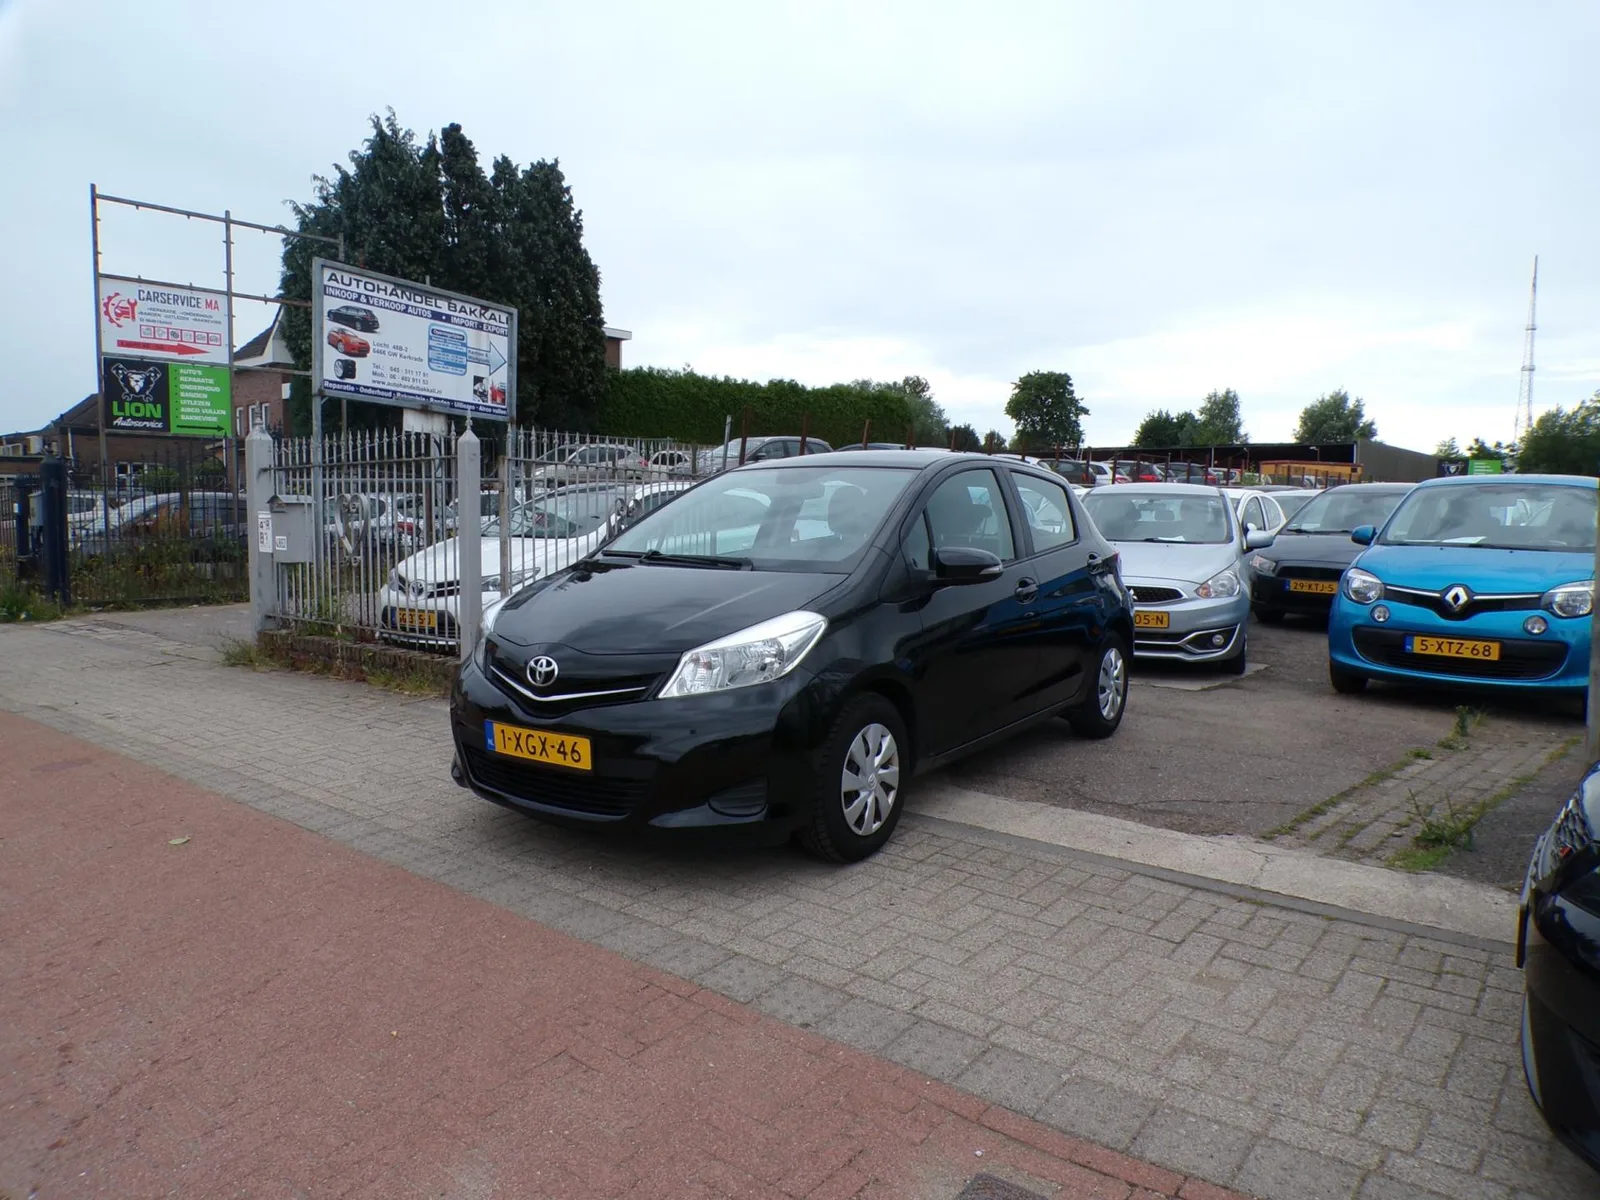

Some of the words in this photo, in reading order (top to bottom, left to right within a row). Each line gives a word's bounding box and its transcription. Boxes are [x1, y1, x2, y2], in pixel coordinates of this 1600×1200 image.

[138, 289, 202, 309] CARSERVICE
[204, 298, 220, 311] MA
[325, 286, 359, 301] INKOOP
[360, 294, 368, 304] &
[368, 296, 406, 312] VERKOOP
[407, 306, 432, 318] AUTOS
[327, 272, 442, 309] AUTOHANDEL
[447, 301, 509, 326] BAKKALI
[450, 315, 478, 329] IMPORT
[482, 323, 508, 336] EXPORT
[324, 380, 355, 392] Reparatie
[359, 386, 393, 397] Onderhoud
[112, 400, 162, 418] LION
[112, 416, 164, 428] Autoservice
[1420, 639, 1492, 657] 5-XTZ-68
[500, 728, 582, 763] 1-XGX-46
